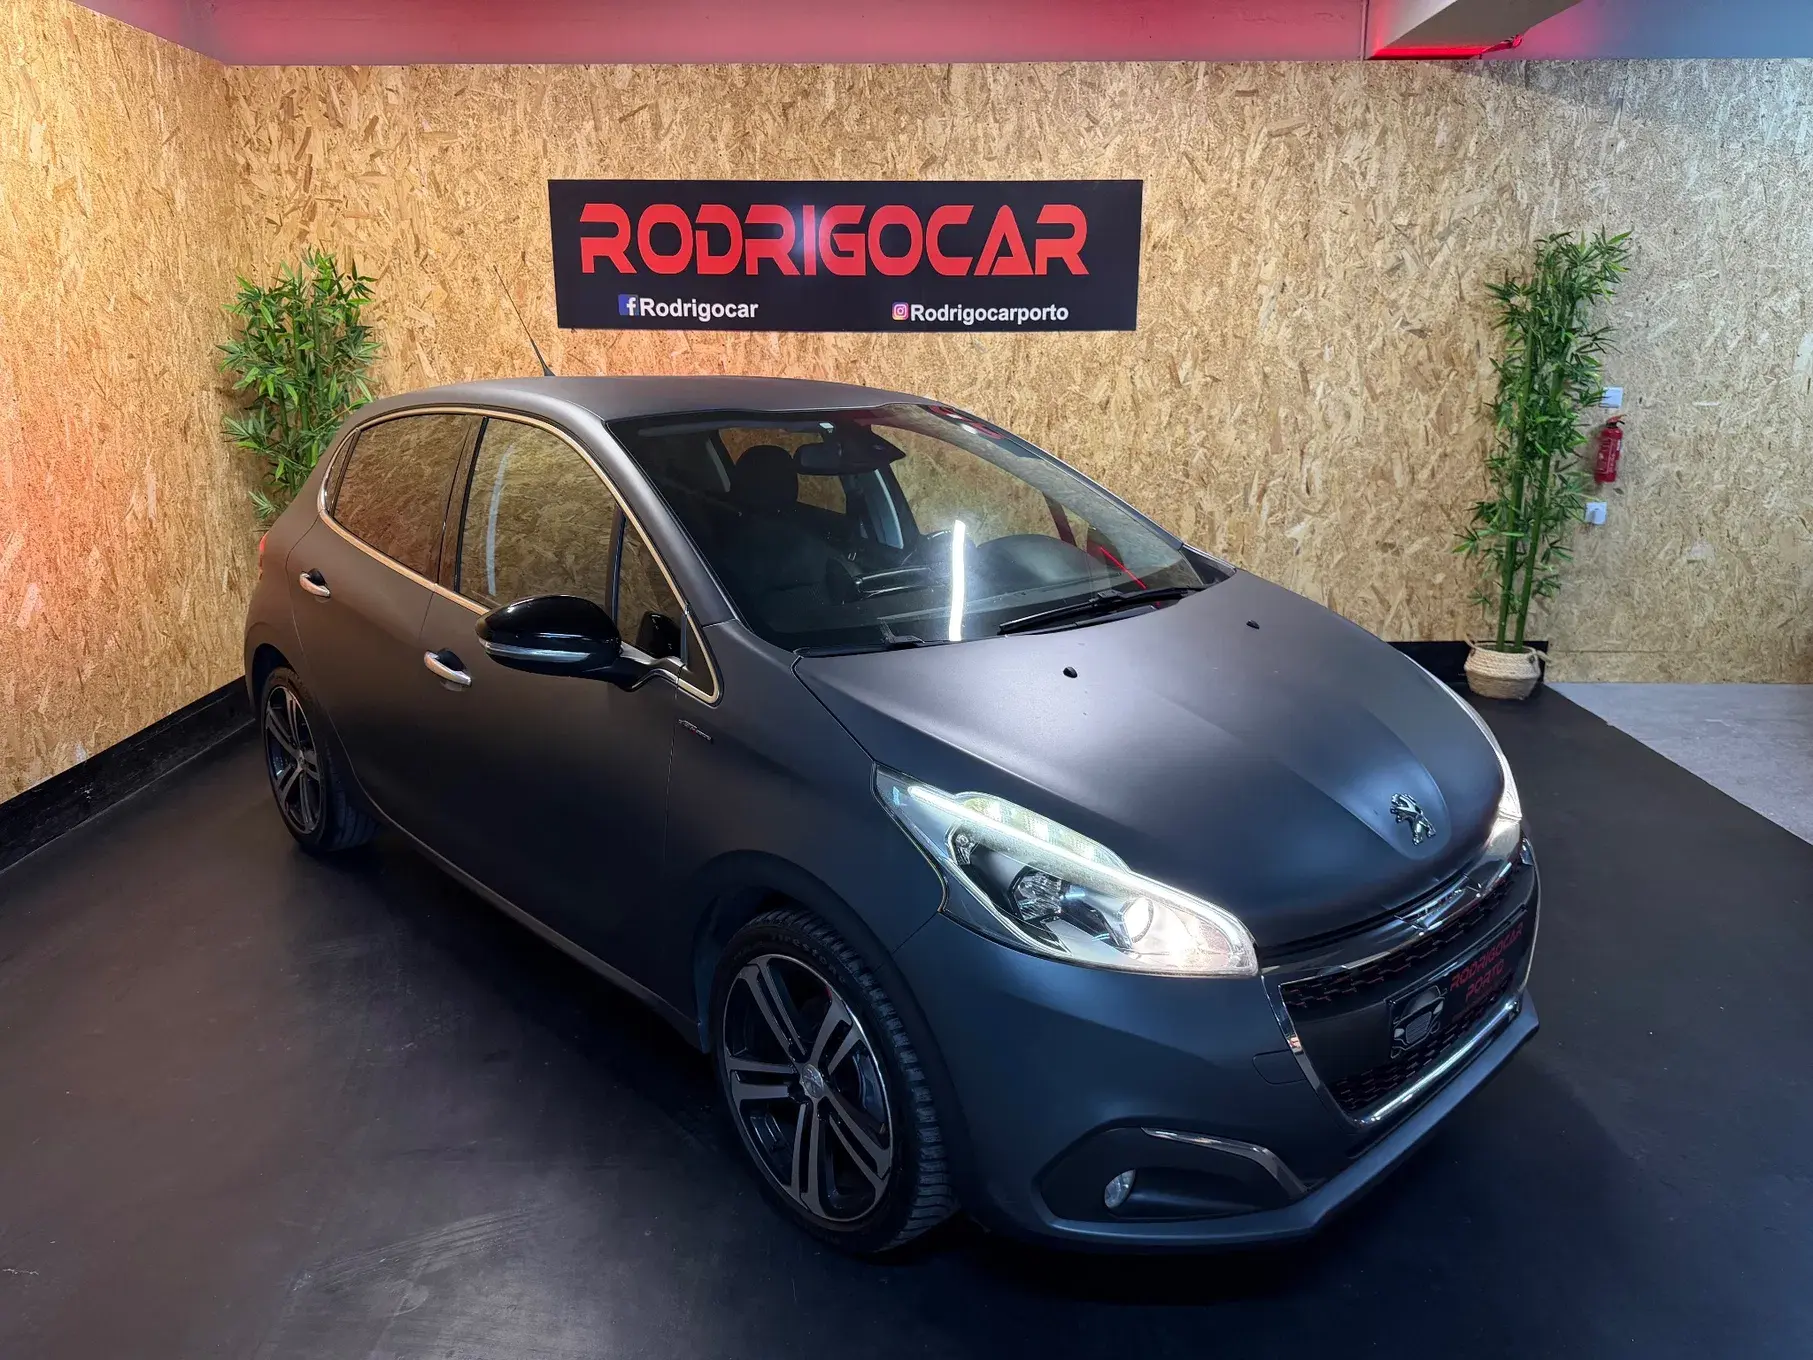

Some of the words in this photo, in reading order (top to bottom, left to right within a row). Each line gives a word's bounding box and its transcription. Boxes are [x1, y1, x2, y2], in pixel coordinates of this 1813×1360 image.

[580, 203, 1090, 276] RODRIGOCAR
[640, 298, 759, 321] Rodrigocar
[910, 303, 1070, 325] Rodrigocarporto
[1450, 922, 1523, 991] RODRIGOCAR
[1466, 959, 1504, 1000] PORTO
